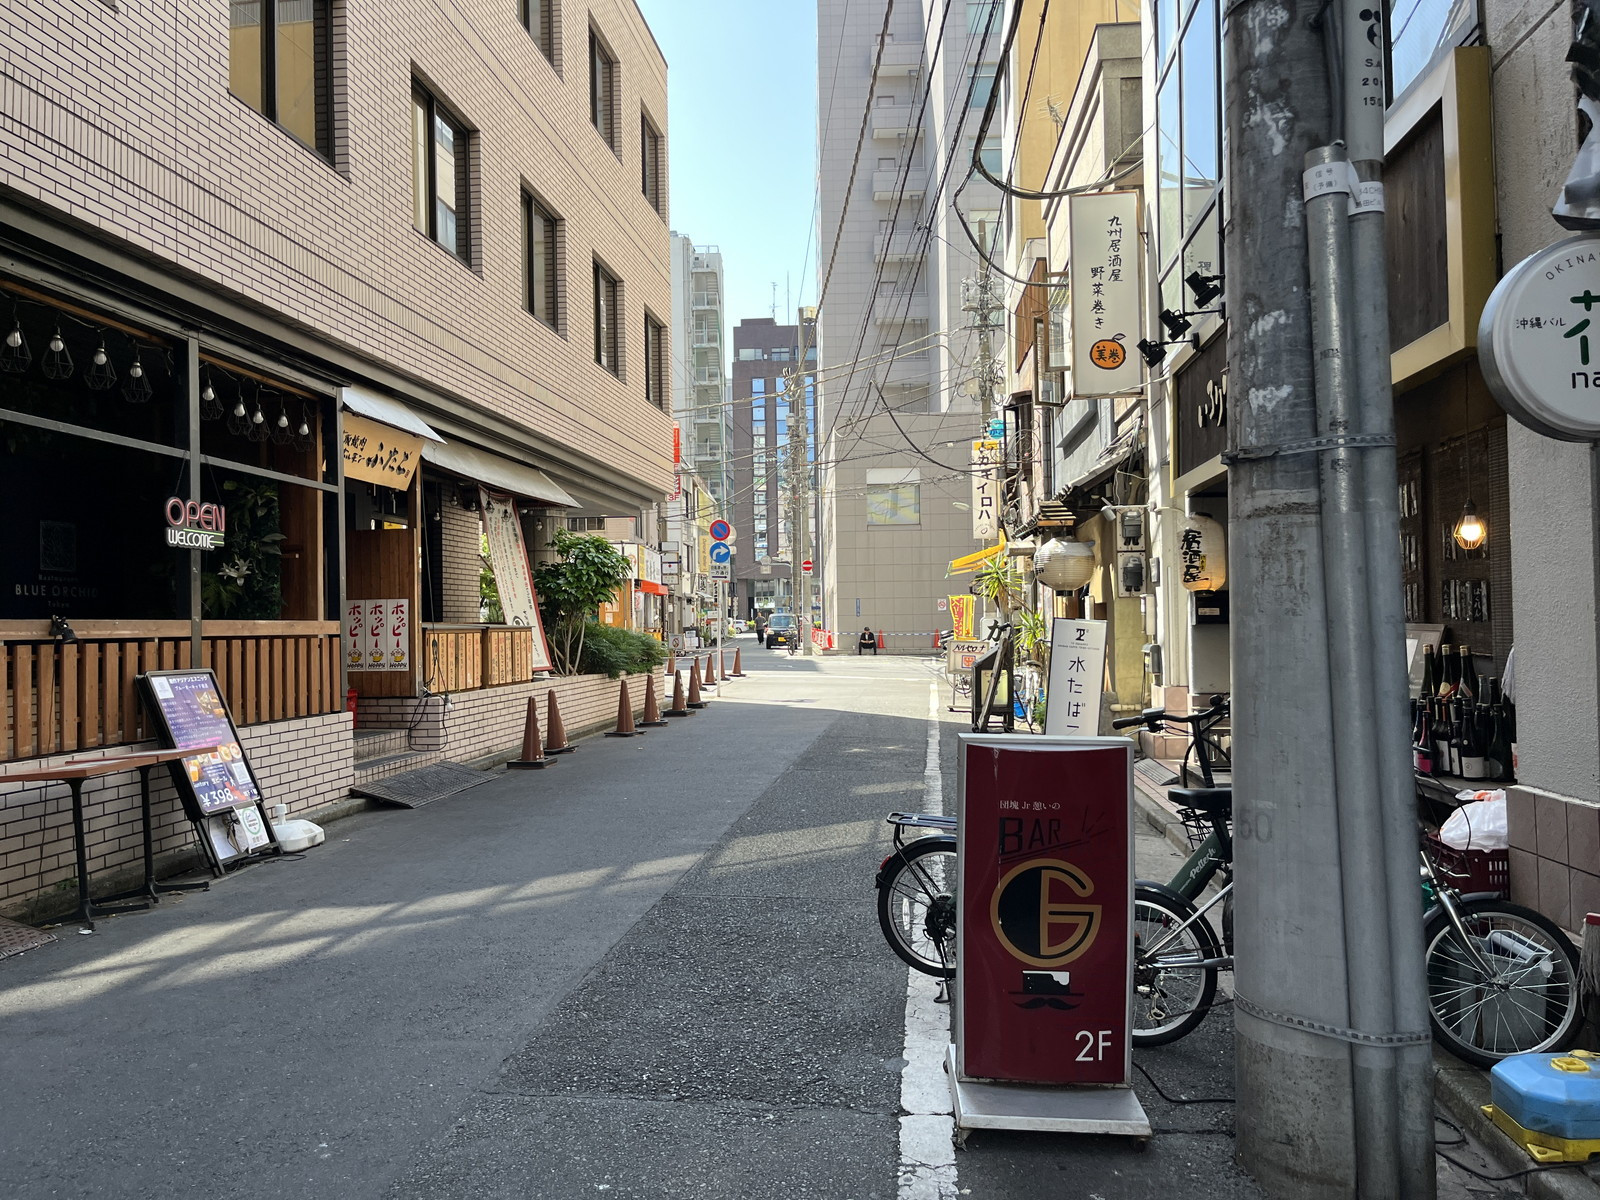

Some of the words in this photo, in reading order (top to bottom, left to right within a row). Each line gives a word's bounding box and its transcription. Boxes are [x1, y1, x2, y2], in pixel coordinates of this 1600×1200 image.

[1107, 215, 1123, 283] 九州居酒屋
[1545, 252, 1600, 281] OKINA
[1090, 266, 1107, 330] 野菜巻き
[1515, 317, 1567, 329] 沖縄バル
[1095, 344, 1121, 364] 美巻
[977, 455, 993, 520] カキイロハ
[166, 497, 226, 532] OPEN
[168, 528, 215, 549] WELCOME
[1180, 528, 1209, 583] 居酒屋
[15, 583, 47, 596] BLUE
[51, 585, 98, 598] ORCHID
[348, 602, 363, 648] ホッピー
[370, 602, 384, 648] ホッピー
[391, 602, 406, 648] ホッピー
[200, 787, 233, 807] ¥398
[999, 799, 1019, 810] 団塊
[1021, 800, 1031, 810] Jr
[1033, 800, 1061, 811] 憩いの
[1000, 817, 1062, 855] BAR
[1074, 1029, 1112, 1062] 2F
